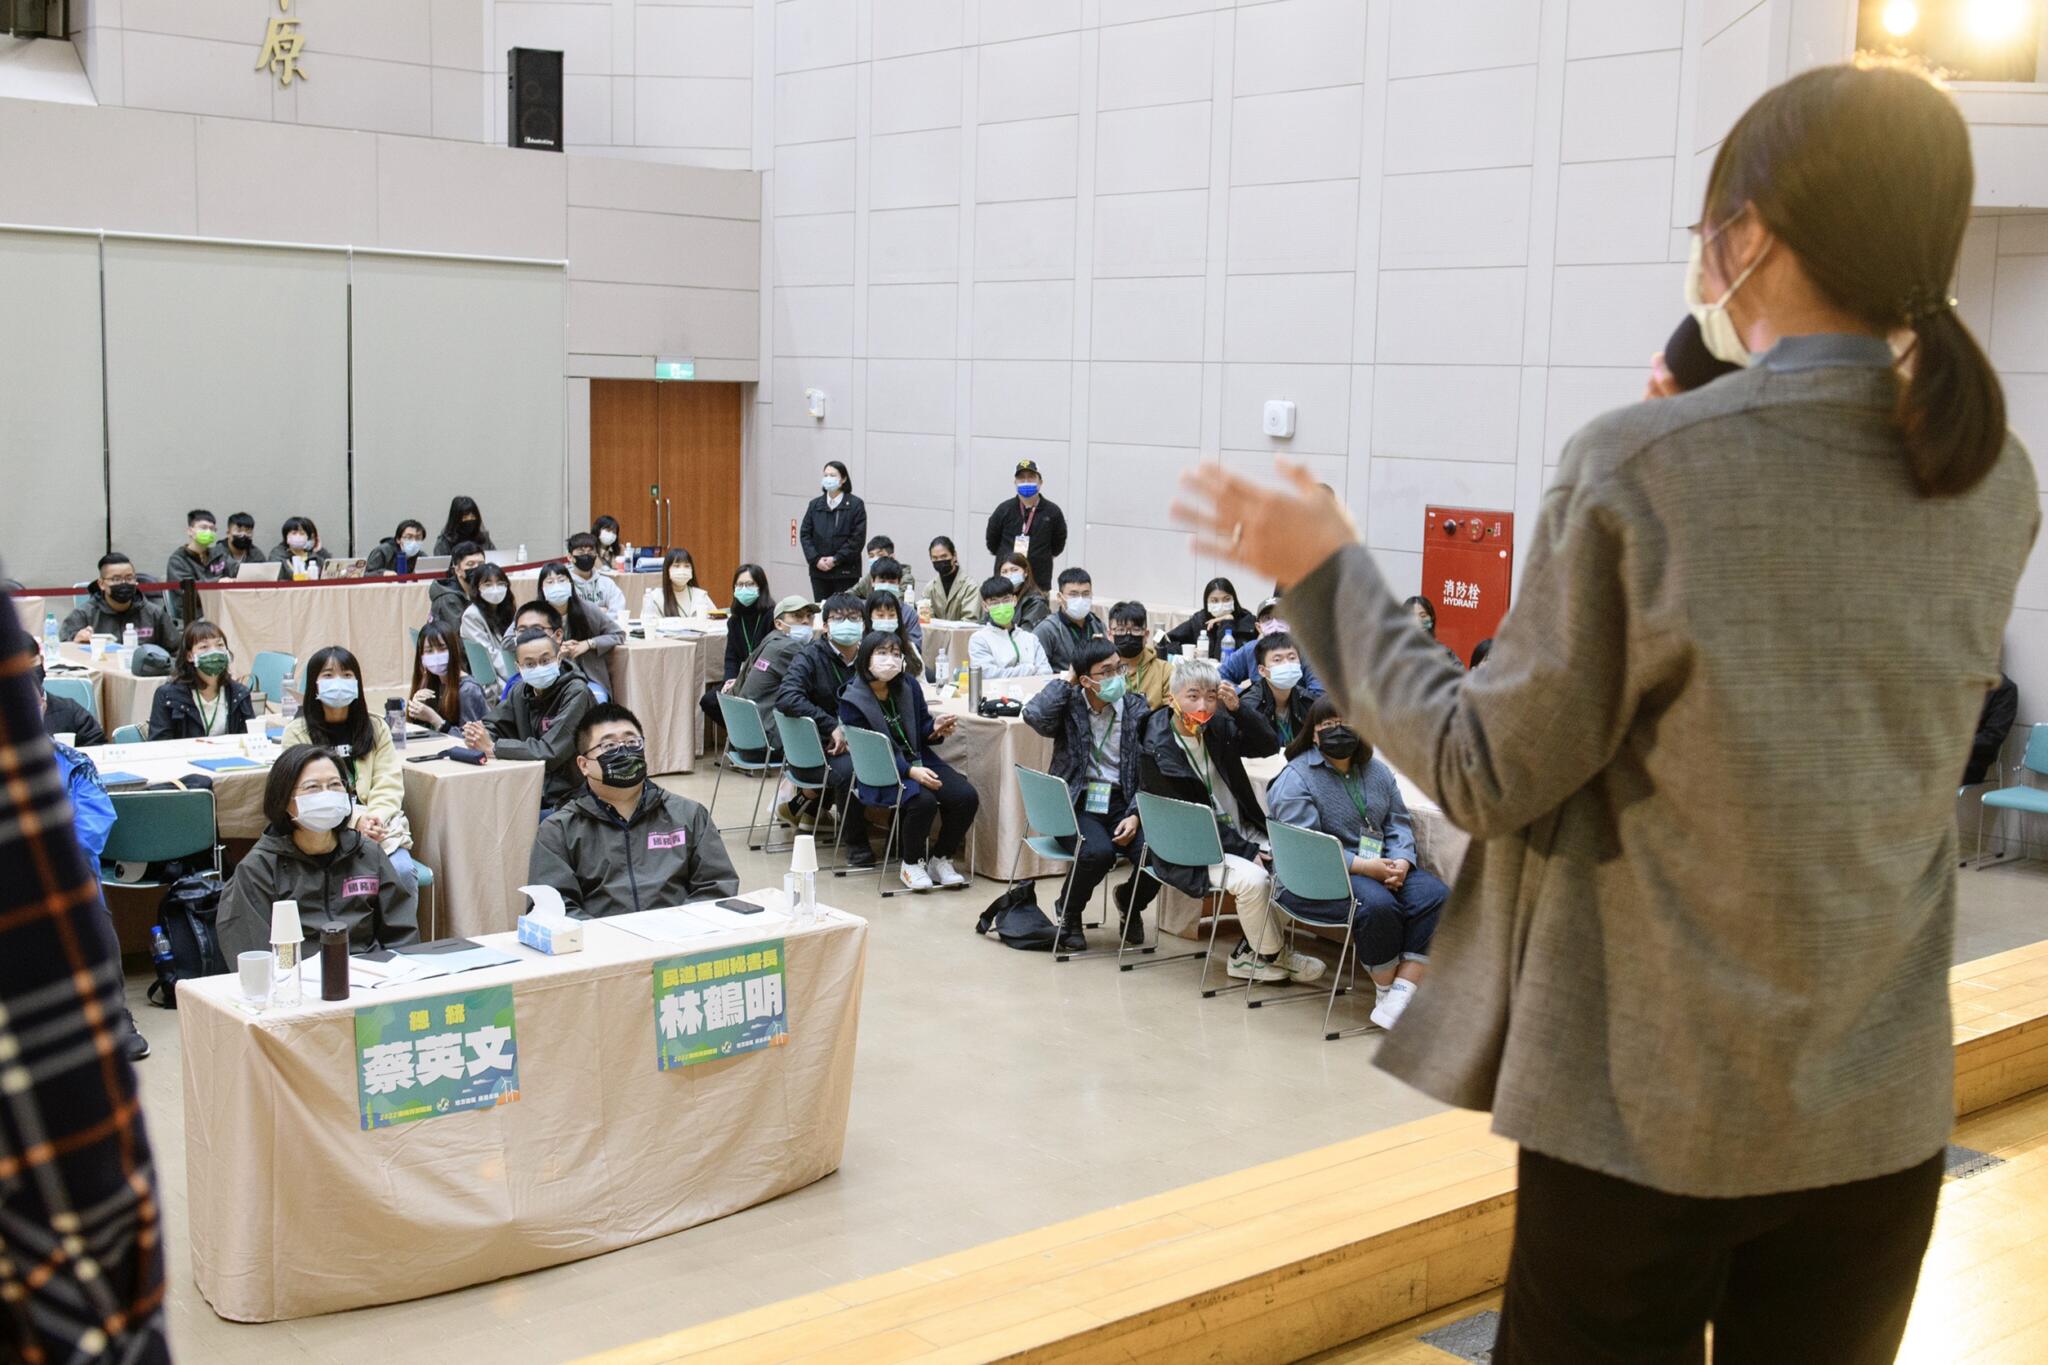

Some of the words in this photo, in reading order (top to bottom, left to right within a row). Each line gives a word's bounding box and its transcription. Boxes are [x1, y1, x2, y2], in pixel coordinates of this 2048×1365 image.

[254, 0, 310, 86] 原
[1443, 579, 1480, 600] 消防栓
[1443, 597, 1479, 609] HYDRANT
[659, 973, 783, 1040] 林鶴明
[362, 1025, 514, 1096] 蔡英文
